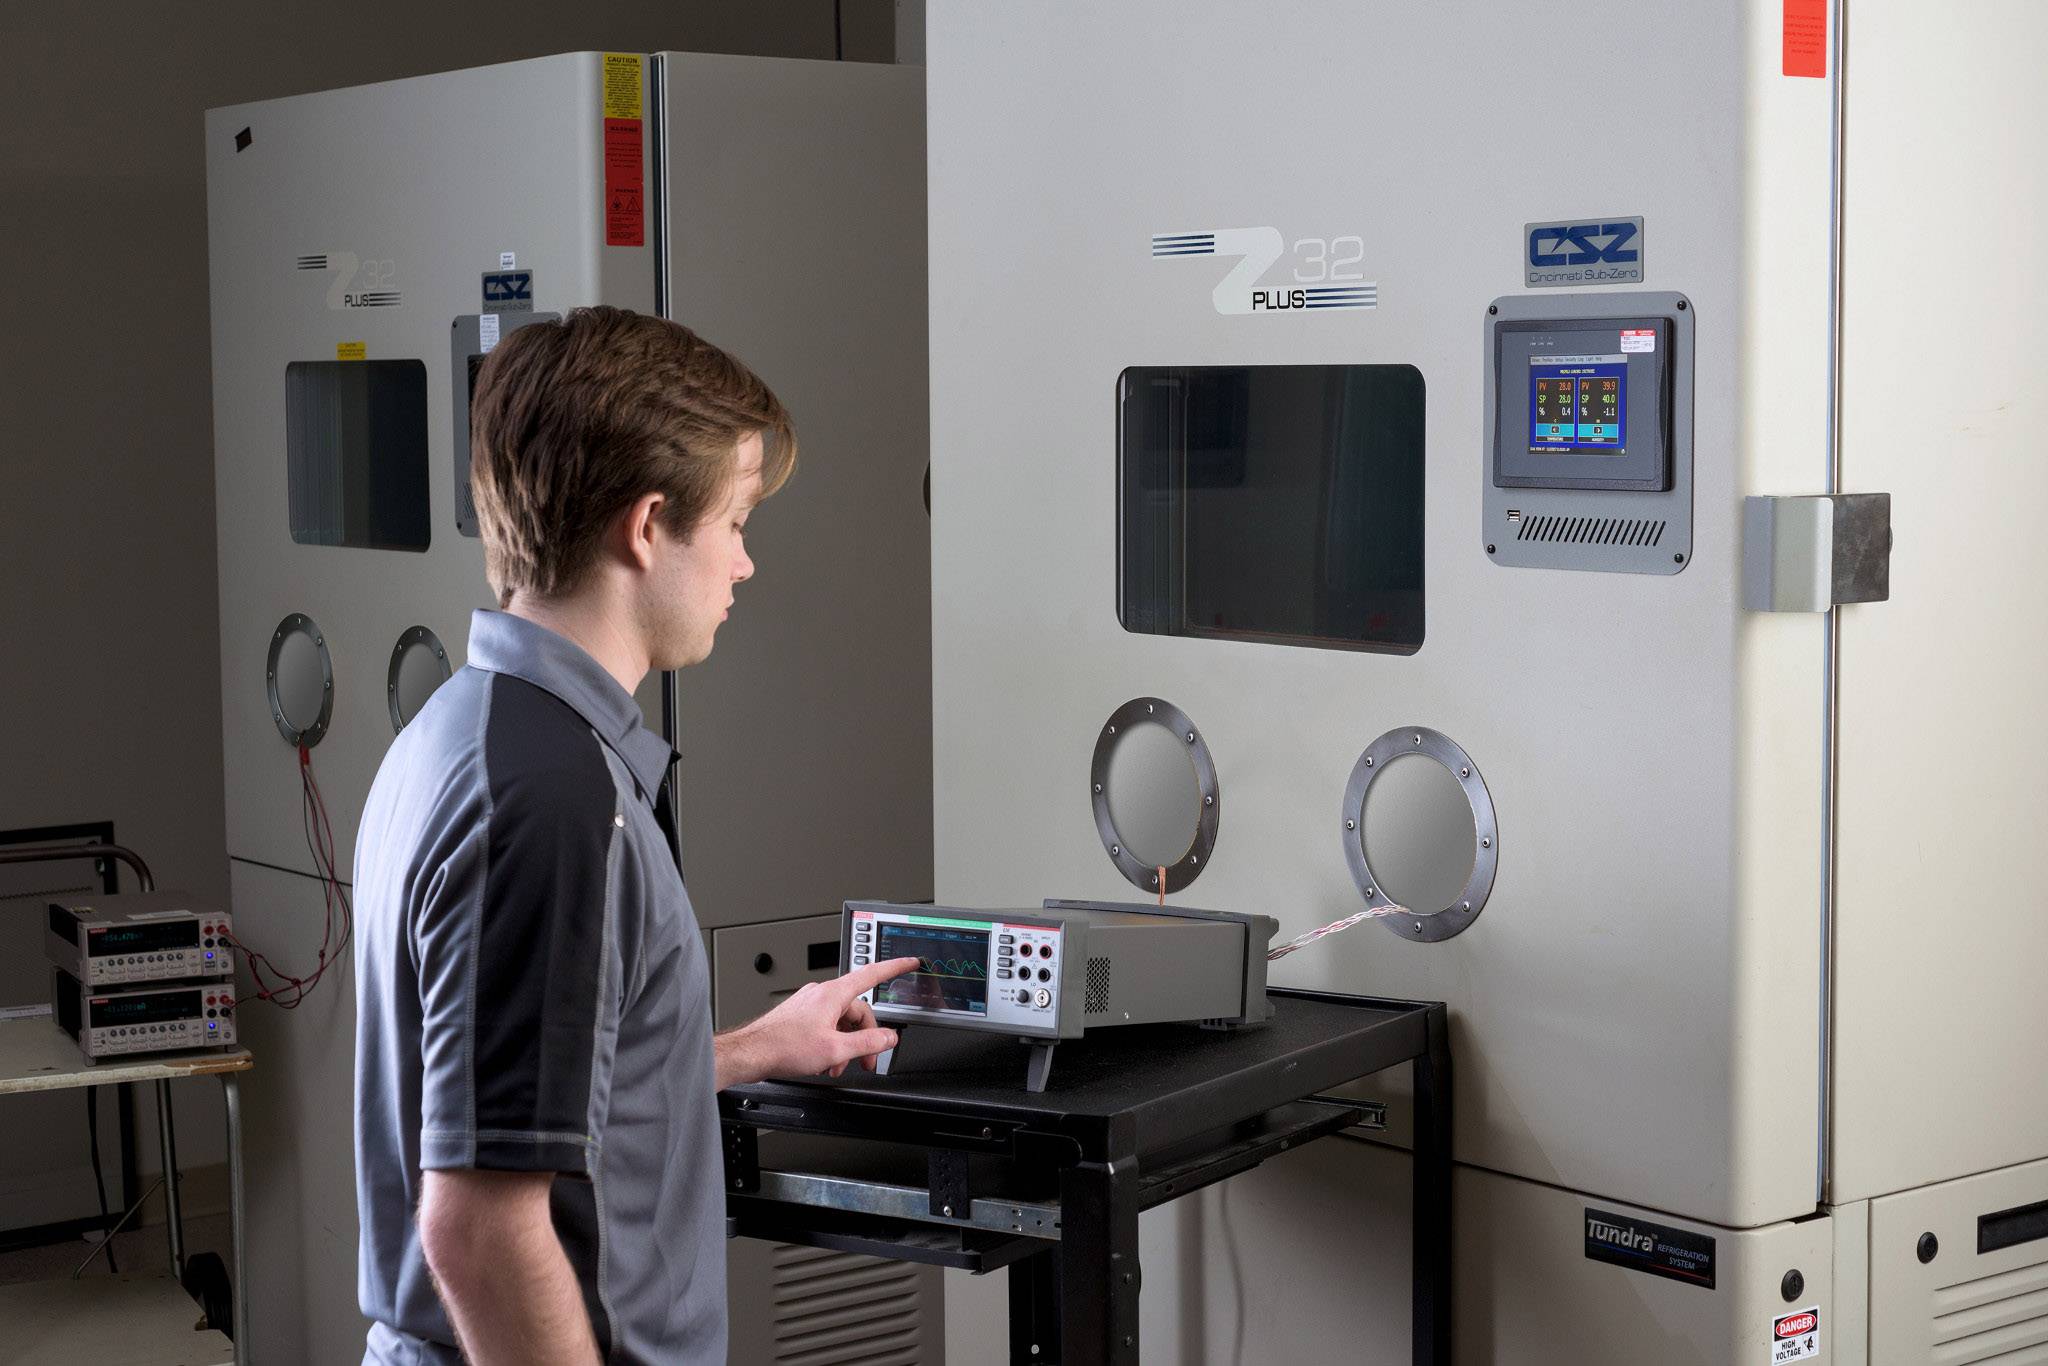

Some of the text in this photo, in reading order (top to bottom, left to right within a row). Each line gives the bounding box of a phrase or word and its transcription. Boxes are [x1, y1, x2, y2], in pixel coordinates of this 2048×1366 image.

[607, 56, 638, 64] CAUTION
[1530, 222, 1638, 267] CSZ
[1293, 236, 1365, 282] 32
[1529, 268, 1638, 283] Cincinnati Sub-Zero
[484, 273, 531, 301] CSZ
[344, 294, 369, 307] PLUS
[1252, 290, 1306, 310] PLUS
[1539, 382, 1547, 391] PV
[1581, 381, 1616, 390] PV 39.9
[1538, 394, 1547, 403] SP
[1581, 394, 1616, 403] SP 40.0
[1538, 407, 1571, 416] % 0.4
[1581, 407, 1615, 416] % -1.1
[1588, 1219, 1654, 1252] Tundra
[1657, 1243, 1710, 1263] REFRIGERATION
[1669, 1257, 1696, 1270] SYSTEM
[1780, 1316, 1813, 1334] DANGER
[1782, 1339, 1796, 1350] HIGH
[1776, 1347, 1801, 1360] VOLTAGE
